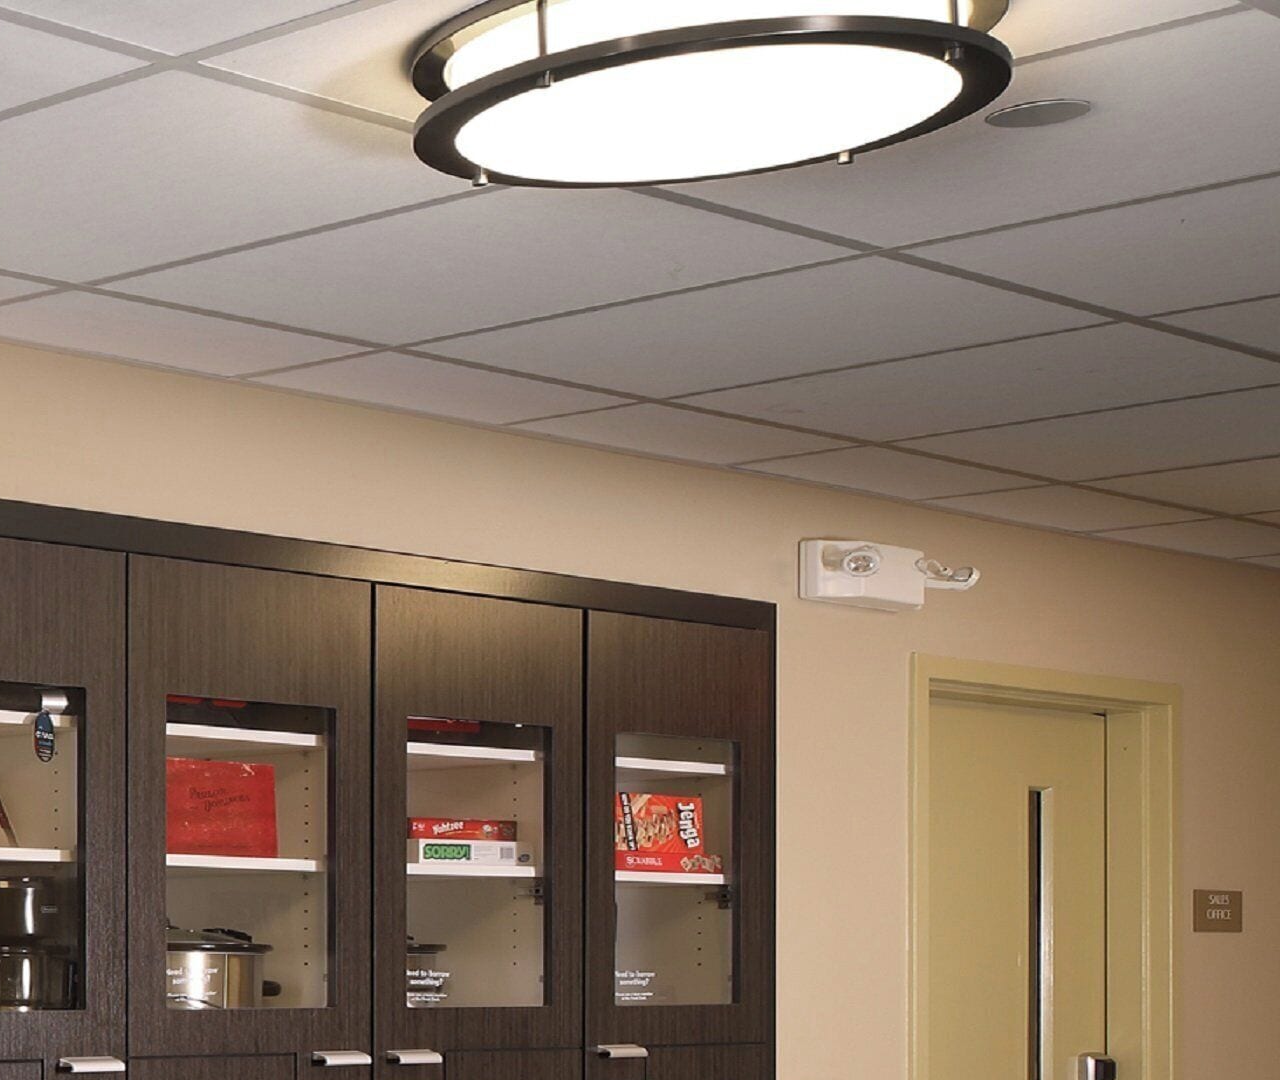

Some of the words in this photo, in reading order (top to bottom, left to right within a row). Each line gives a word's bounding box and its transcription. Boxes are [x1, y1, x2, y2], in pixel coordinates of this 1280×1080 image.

[432, 820, 465, 835] Yahtzee
[678, 802, 700, 848] Jenga
[423, 844, 470, 860] SORRY!
